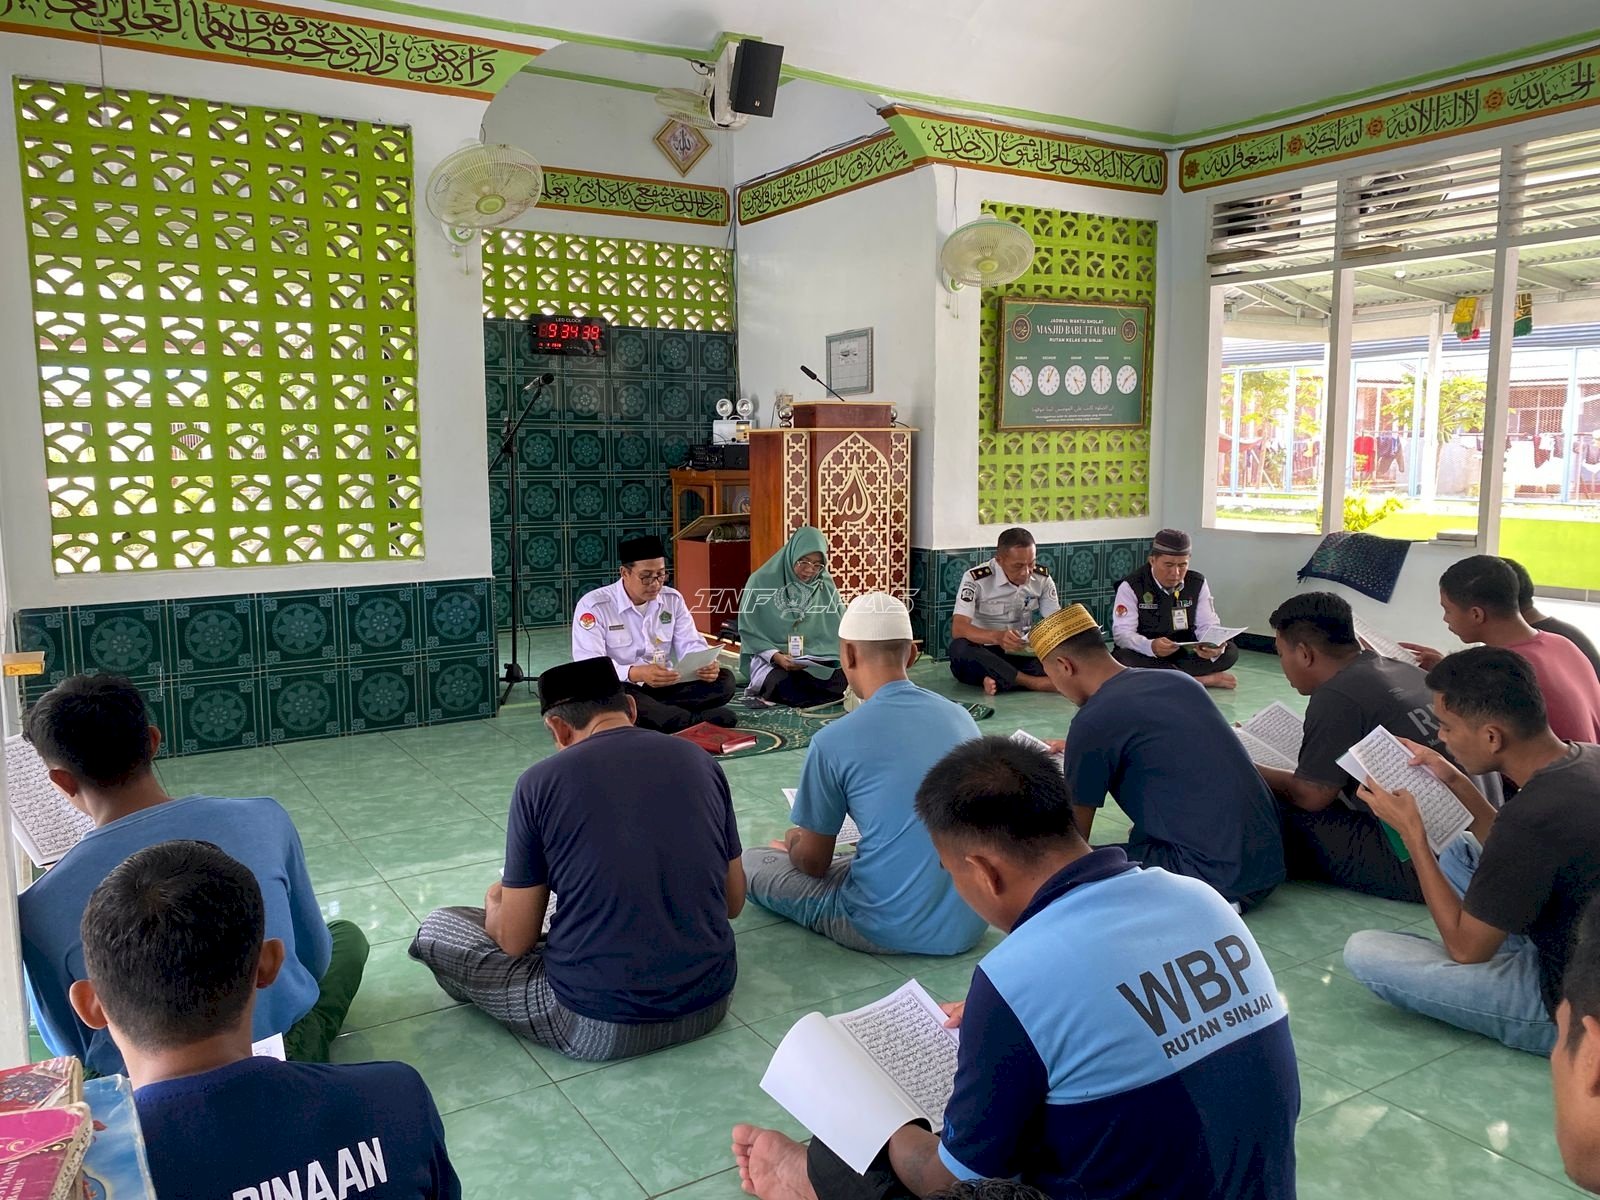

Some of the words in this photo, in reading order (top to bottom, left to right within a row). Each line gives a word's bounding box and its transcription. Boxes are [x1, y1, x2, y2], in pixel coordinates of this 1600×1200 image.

[1036, 325, 1064, 335] MASJID
[1116, 934, 1251, 1037] WBP
[1162, 1017, 1222, 1059] RUTAN
[1223, 993, 1273, 1027] SINJAI
